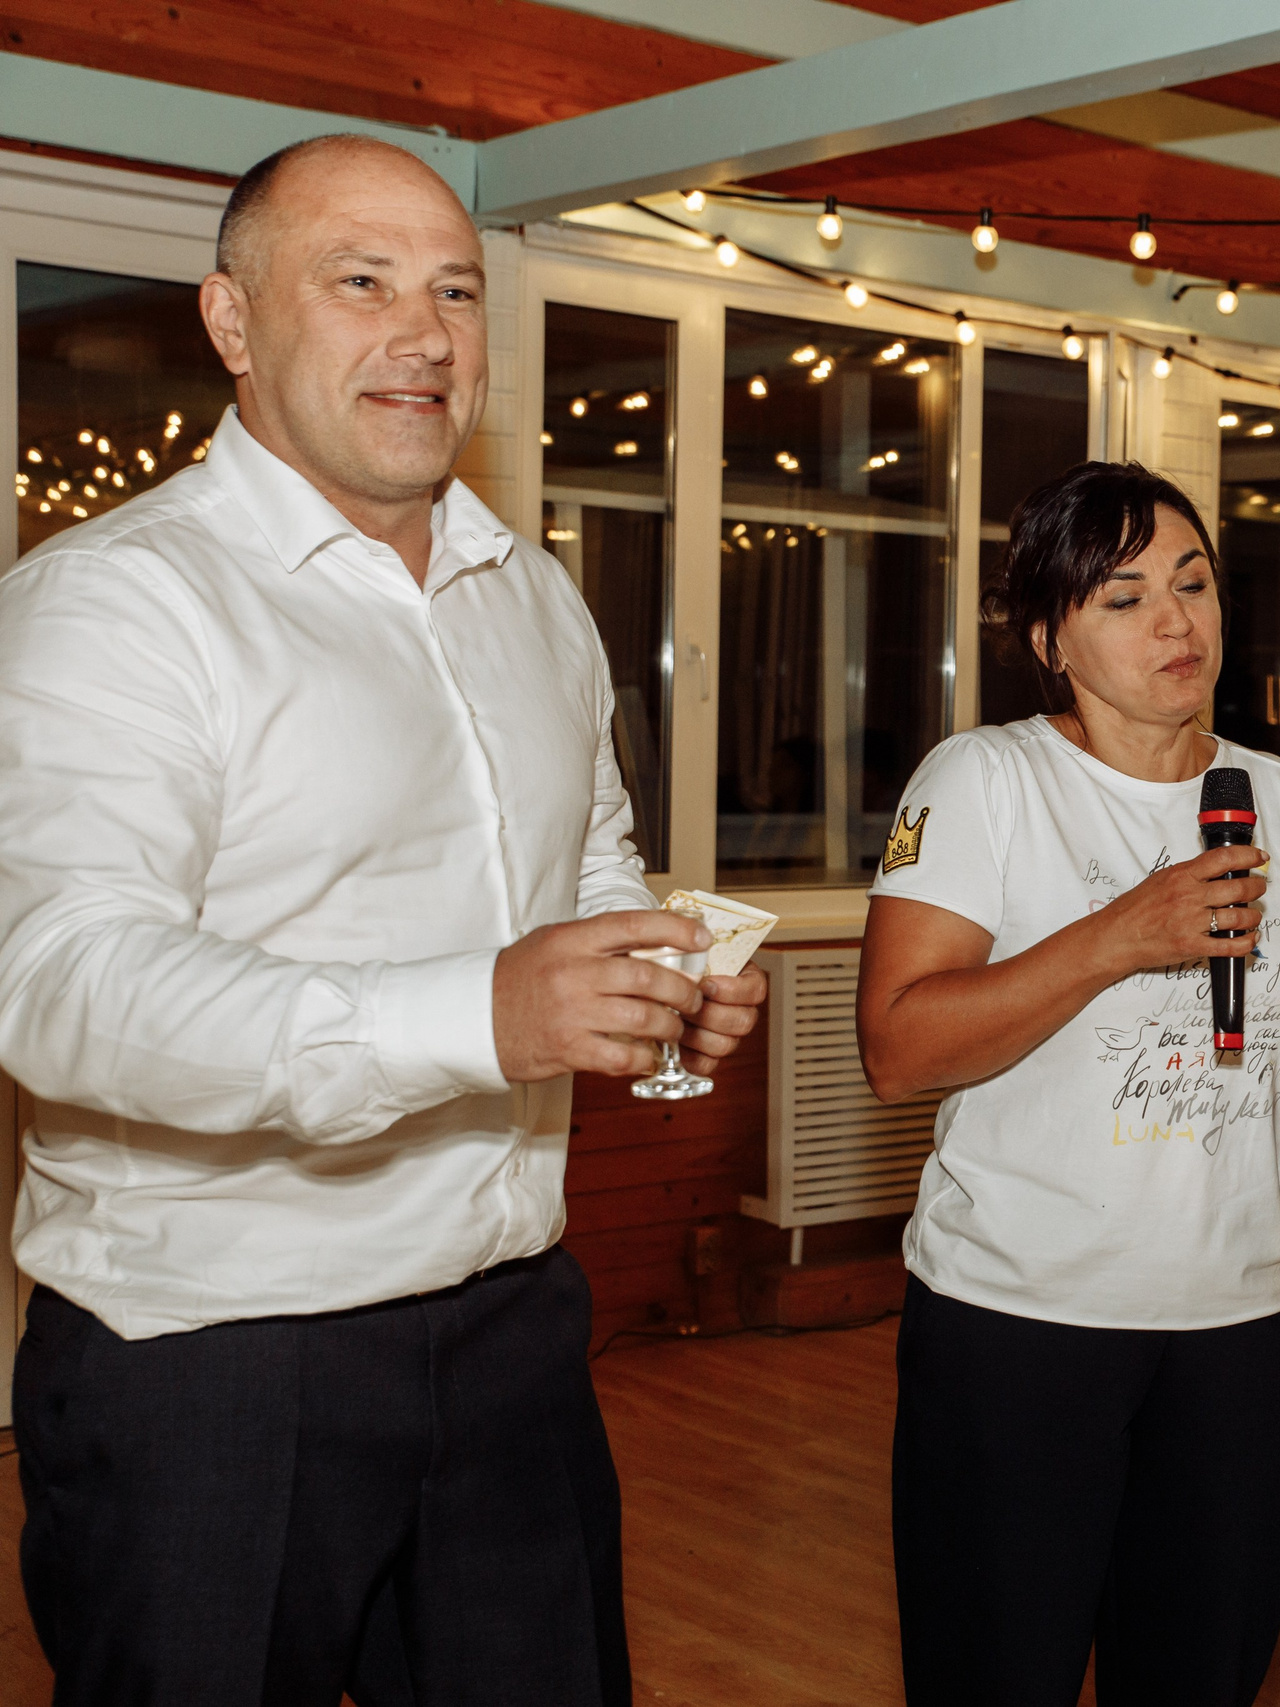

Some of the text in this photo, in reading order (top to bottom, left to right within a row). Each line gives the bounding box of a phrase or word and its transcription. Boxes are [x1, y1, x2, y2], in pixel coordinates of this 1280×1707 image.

[891, 838, 909, 859] 888
[1081, 858, 1120, 885] Все
[1251, 962, 1269, 973] от
[1158, 1024, 1189, 1048] Все
[1112, 1047, 1224, 1119] Королева
[1112, 1112, 1195, 1146] LUNA
